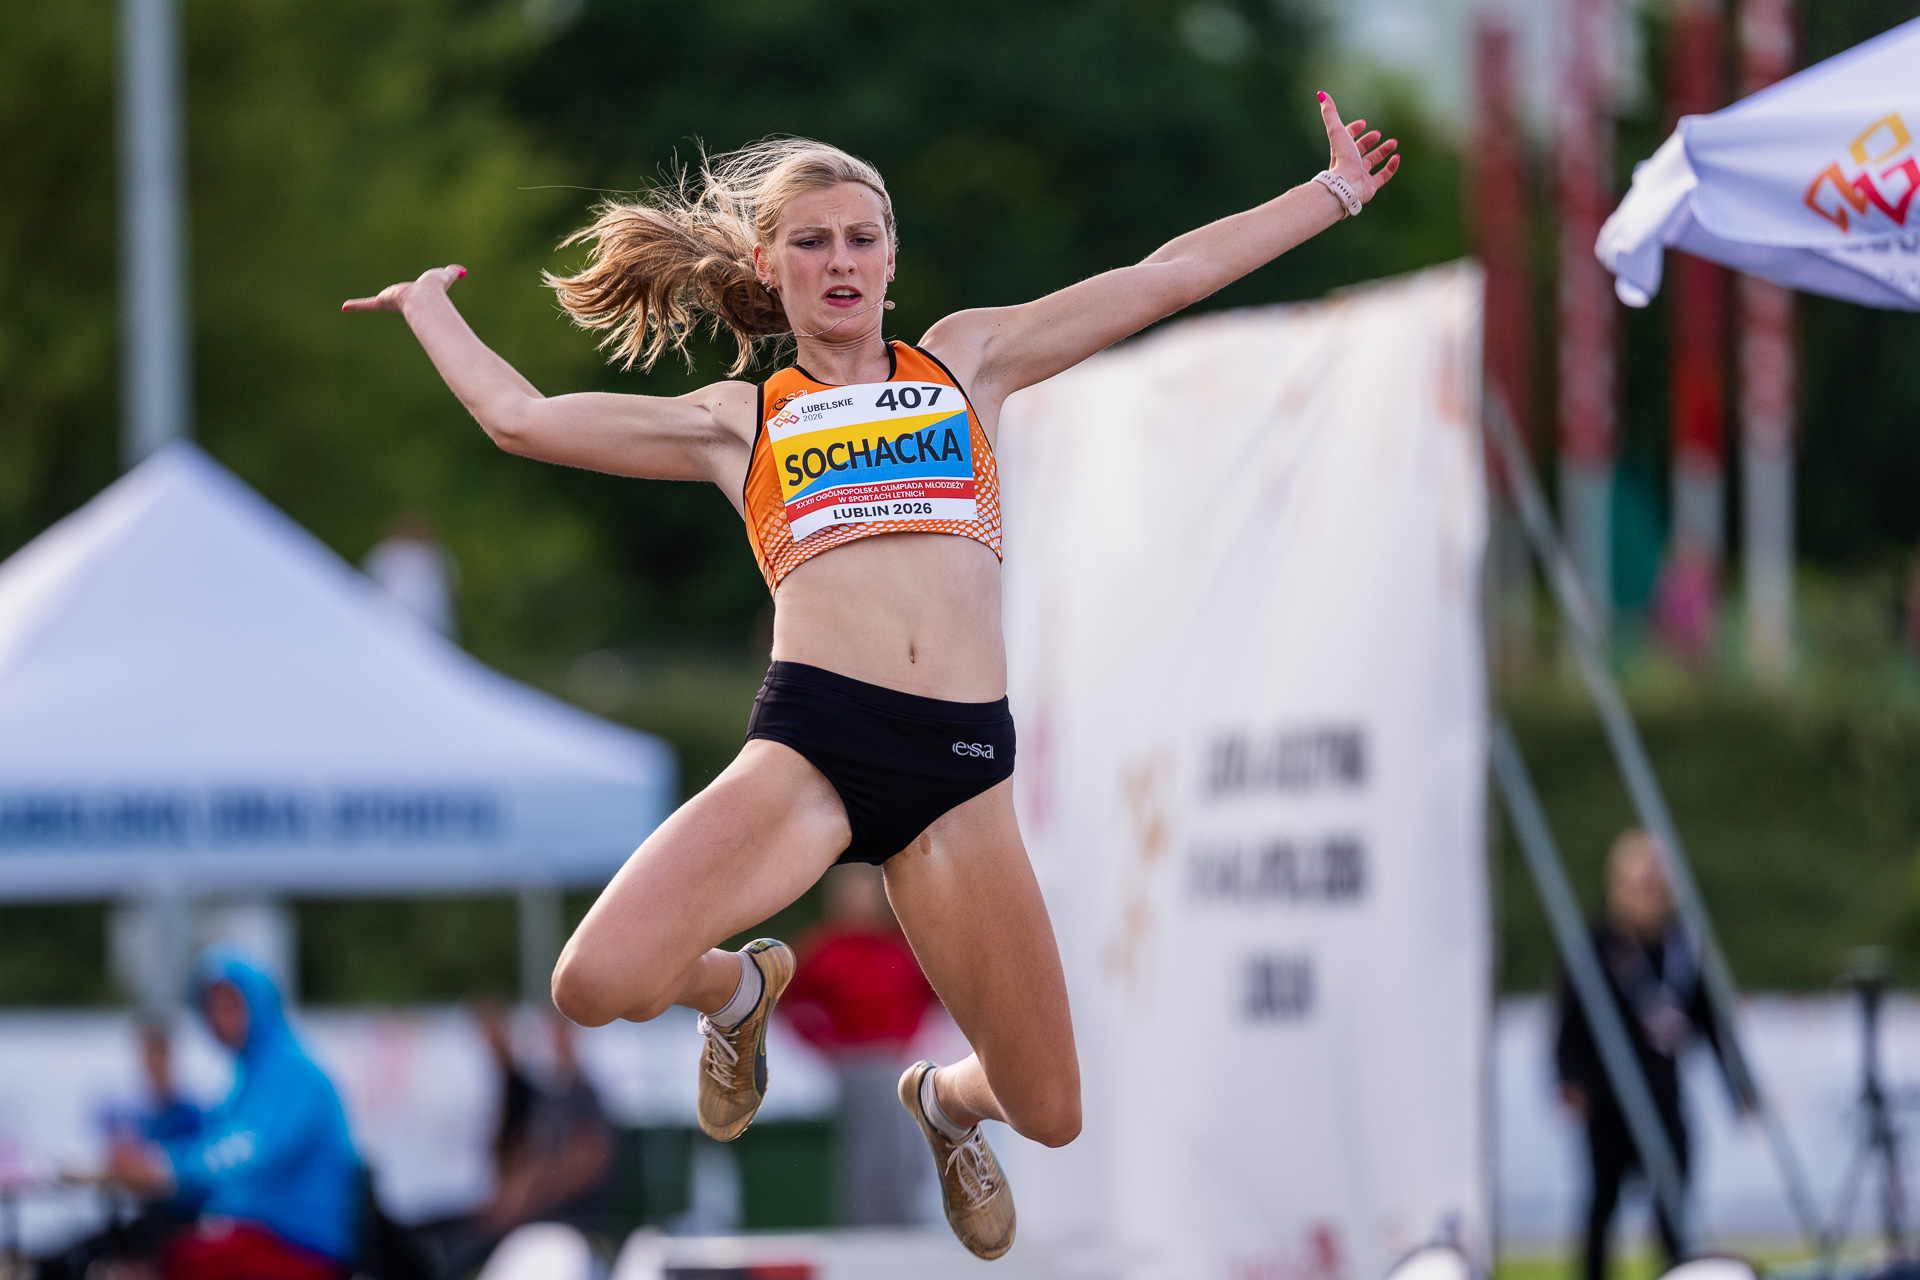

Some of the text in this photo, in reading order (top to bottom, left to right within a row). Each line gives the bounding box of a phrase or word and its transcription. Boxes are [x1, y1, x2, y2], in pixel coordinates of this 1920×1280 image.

[801, 397, 854, 414] LUBELSKIE
[874, 386, 942, 412] 407
[803, 412, 823, 422] 2026
[784, 427, 964, 487] SOCHACKA
[795, 480, 965, 510] XXXII OGÓLNOPOLSKA OLIMPIADA MŁODZIEŻY
[848, 492, 891, 503] SPORTACH
[892, 490, 925, 499] LETNICH
[833, 502, 933, 520] LUBLIN 2026
[952, 741, 995, 759] esa
